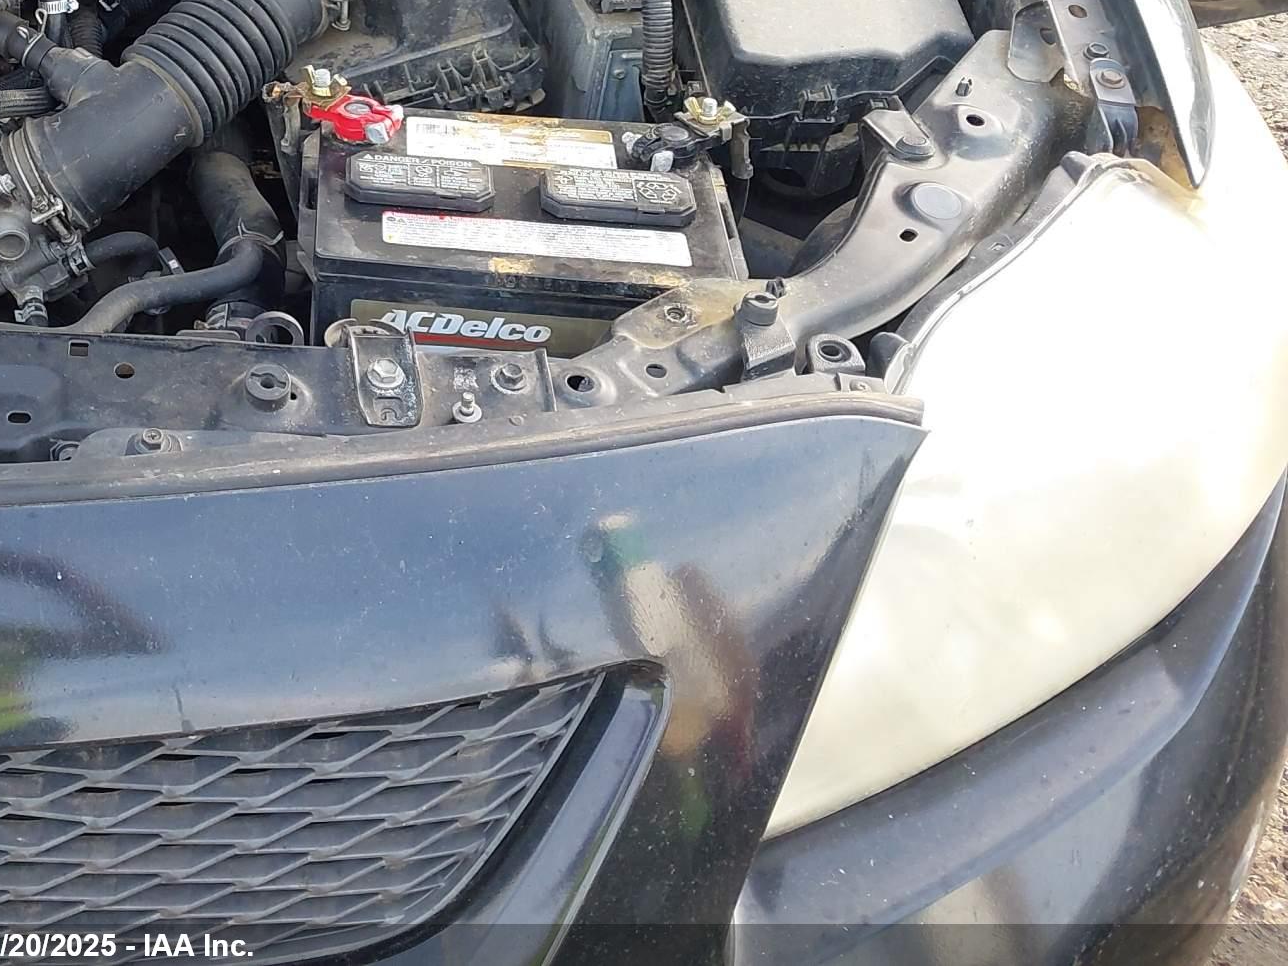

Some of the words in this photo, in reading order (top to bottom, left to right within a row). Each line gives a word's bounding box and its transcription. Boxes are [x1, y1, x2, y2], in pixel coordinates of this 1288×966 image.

[374, 154, 419, 165] DANGER
[429, 159, 473, 168] POISON
[381, 308, 552, 343] ACDelco
